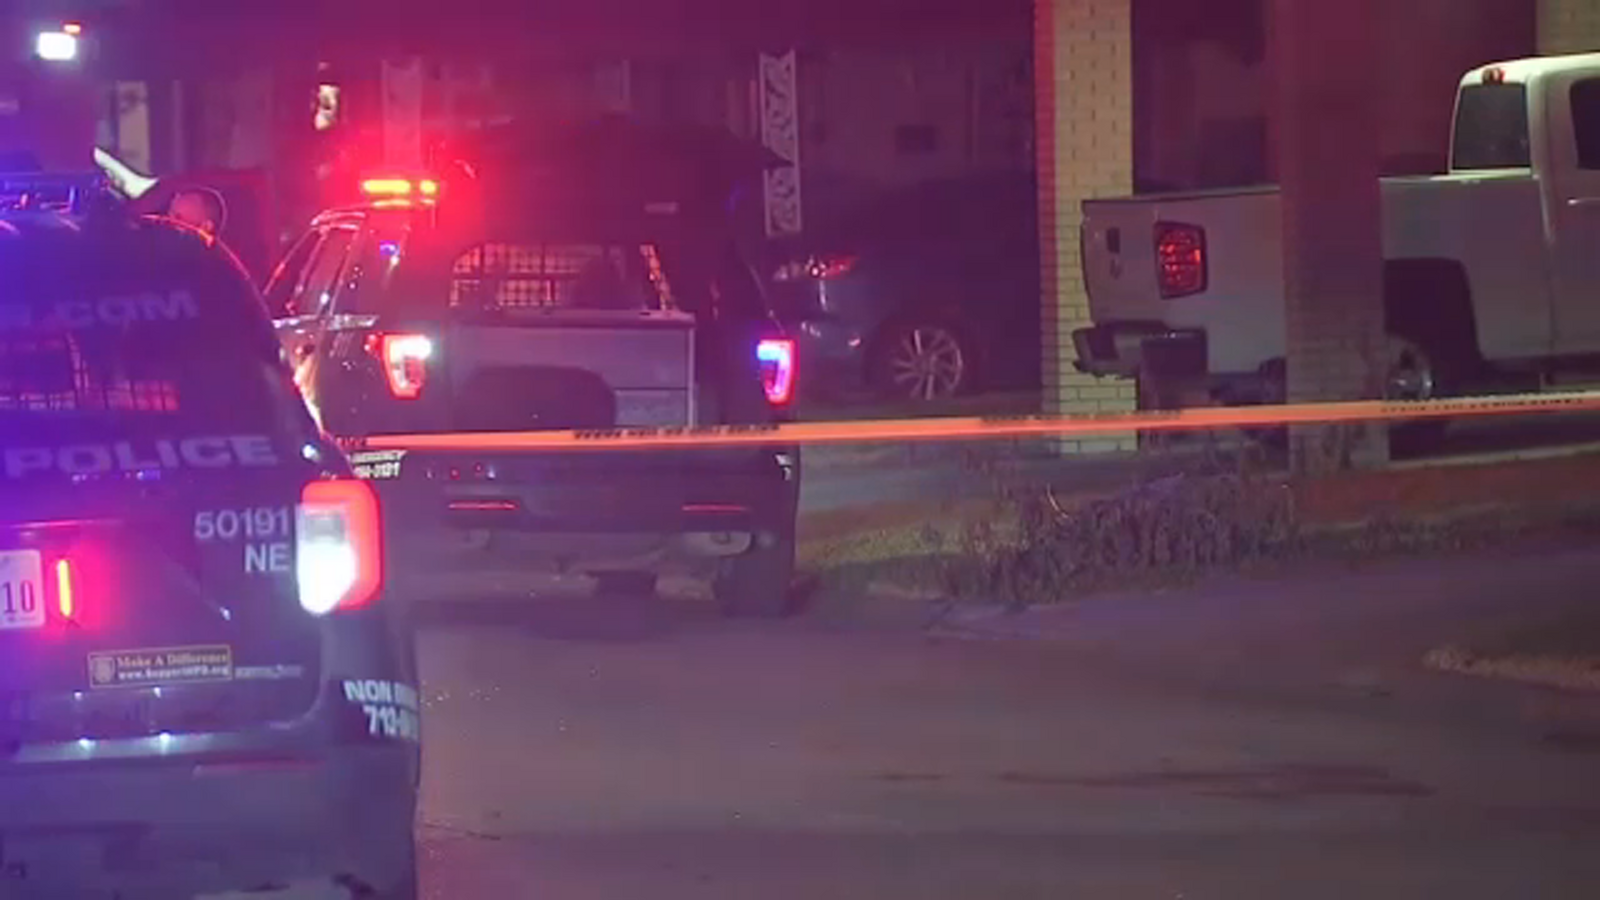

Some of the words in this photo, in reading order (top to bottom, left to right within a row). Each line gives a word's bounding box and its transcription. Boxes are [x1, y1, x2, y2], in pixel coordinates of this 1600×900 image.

[4, 434, 279, 479] POLICE
[193, 506, 290, 540] 50191
[244, 543, 291, 573] NE
[116, 655, 151, 668] Make
[153, 654, 165, 667] A
[166, 651, 228, 666] Difference
[343, 679, 392, 703] NON
